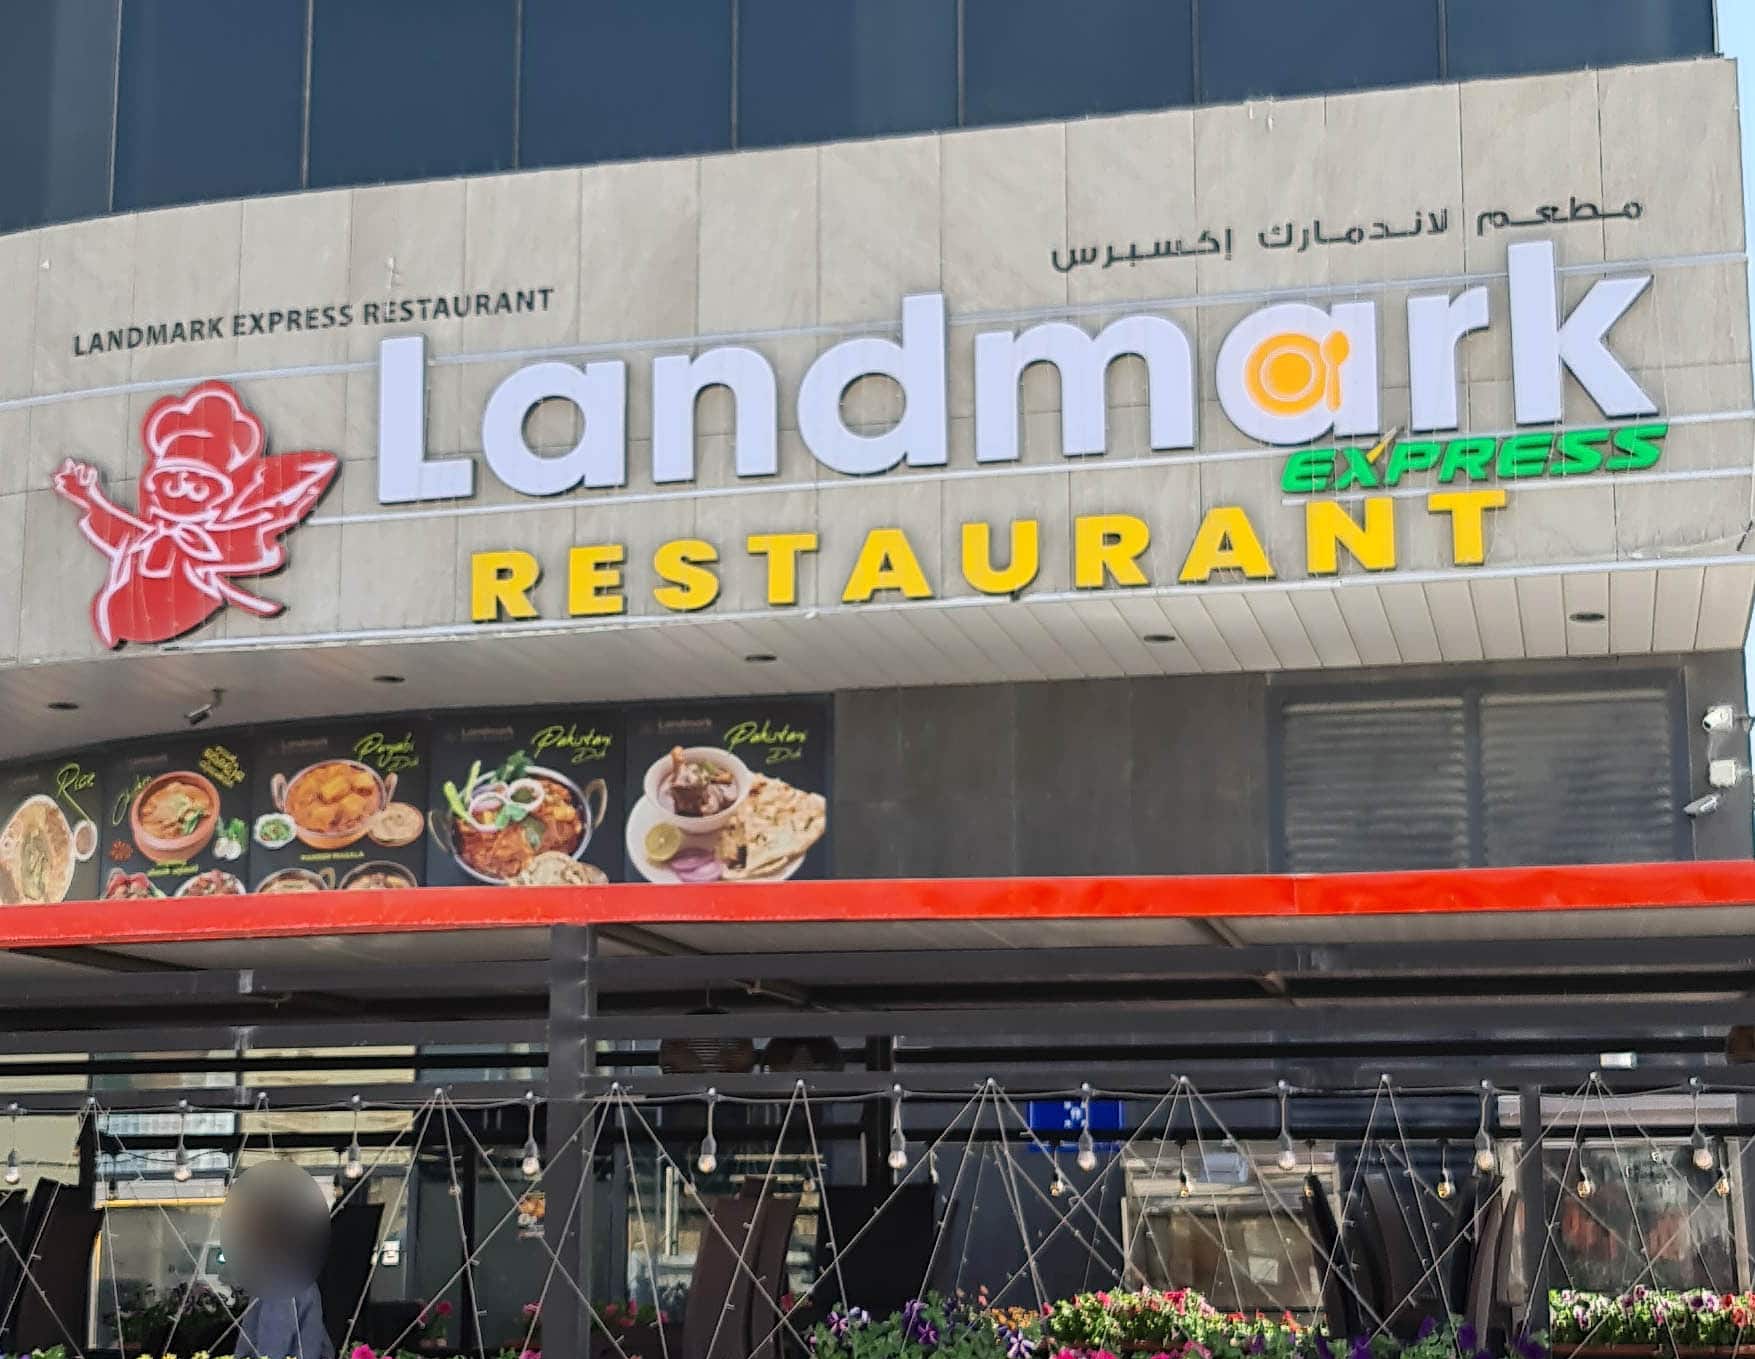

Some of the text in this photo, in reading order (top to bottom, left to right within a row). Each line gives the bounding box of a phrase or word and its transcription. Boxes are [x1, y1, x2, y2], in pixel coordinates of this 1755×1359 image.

[1050, 197, 1643, 271] مطعم لاندمارك إكسبرس
[73, 288, 555, 357] LANDMARK EXPRESS RESTAURANT
[378, 240, 1660, 505] Landmark
[1281, 421, 1669, 494] EXPRESS
[470, 490, 1509, 622] RESTAURANT
